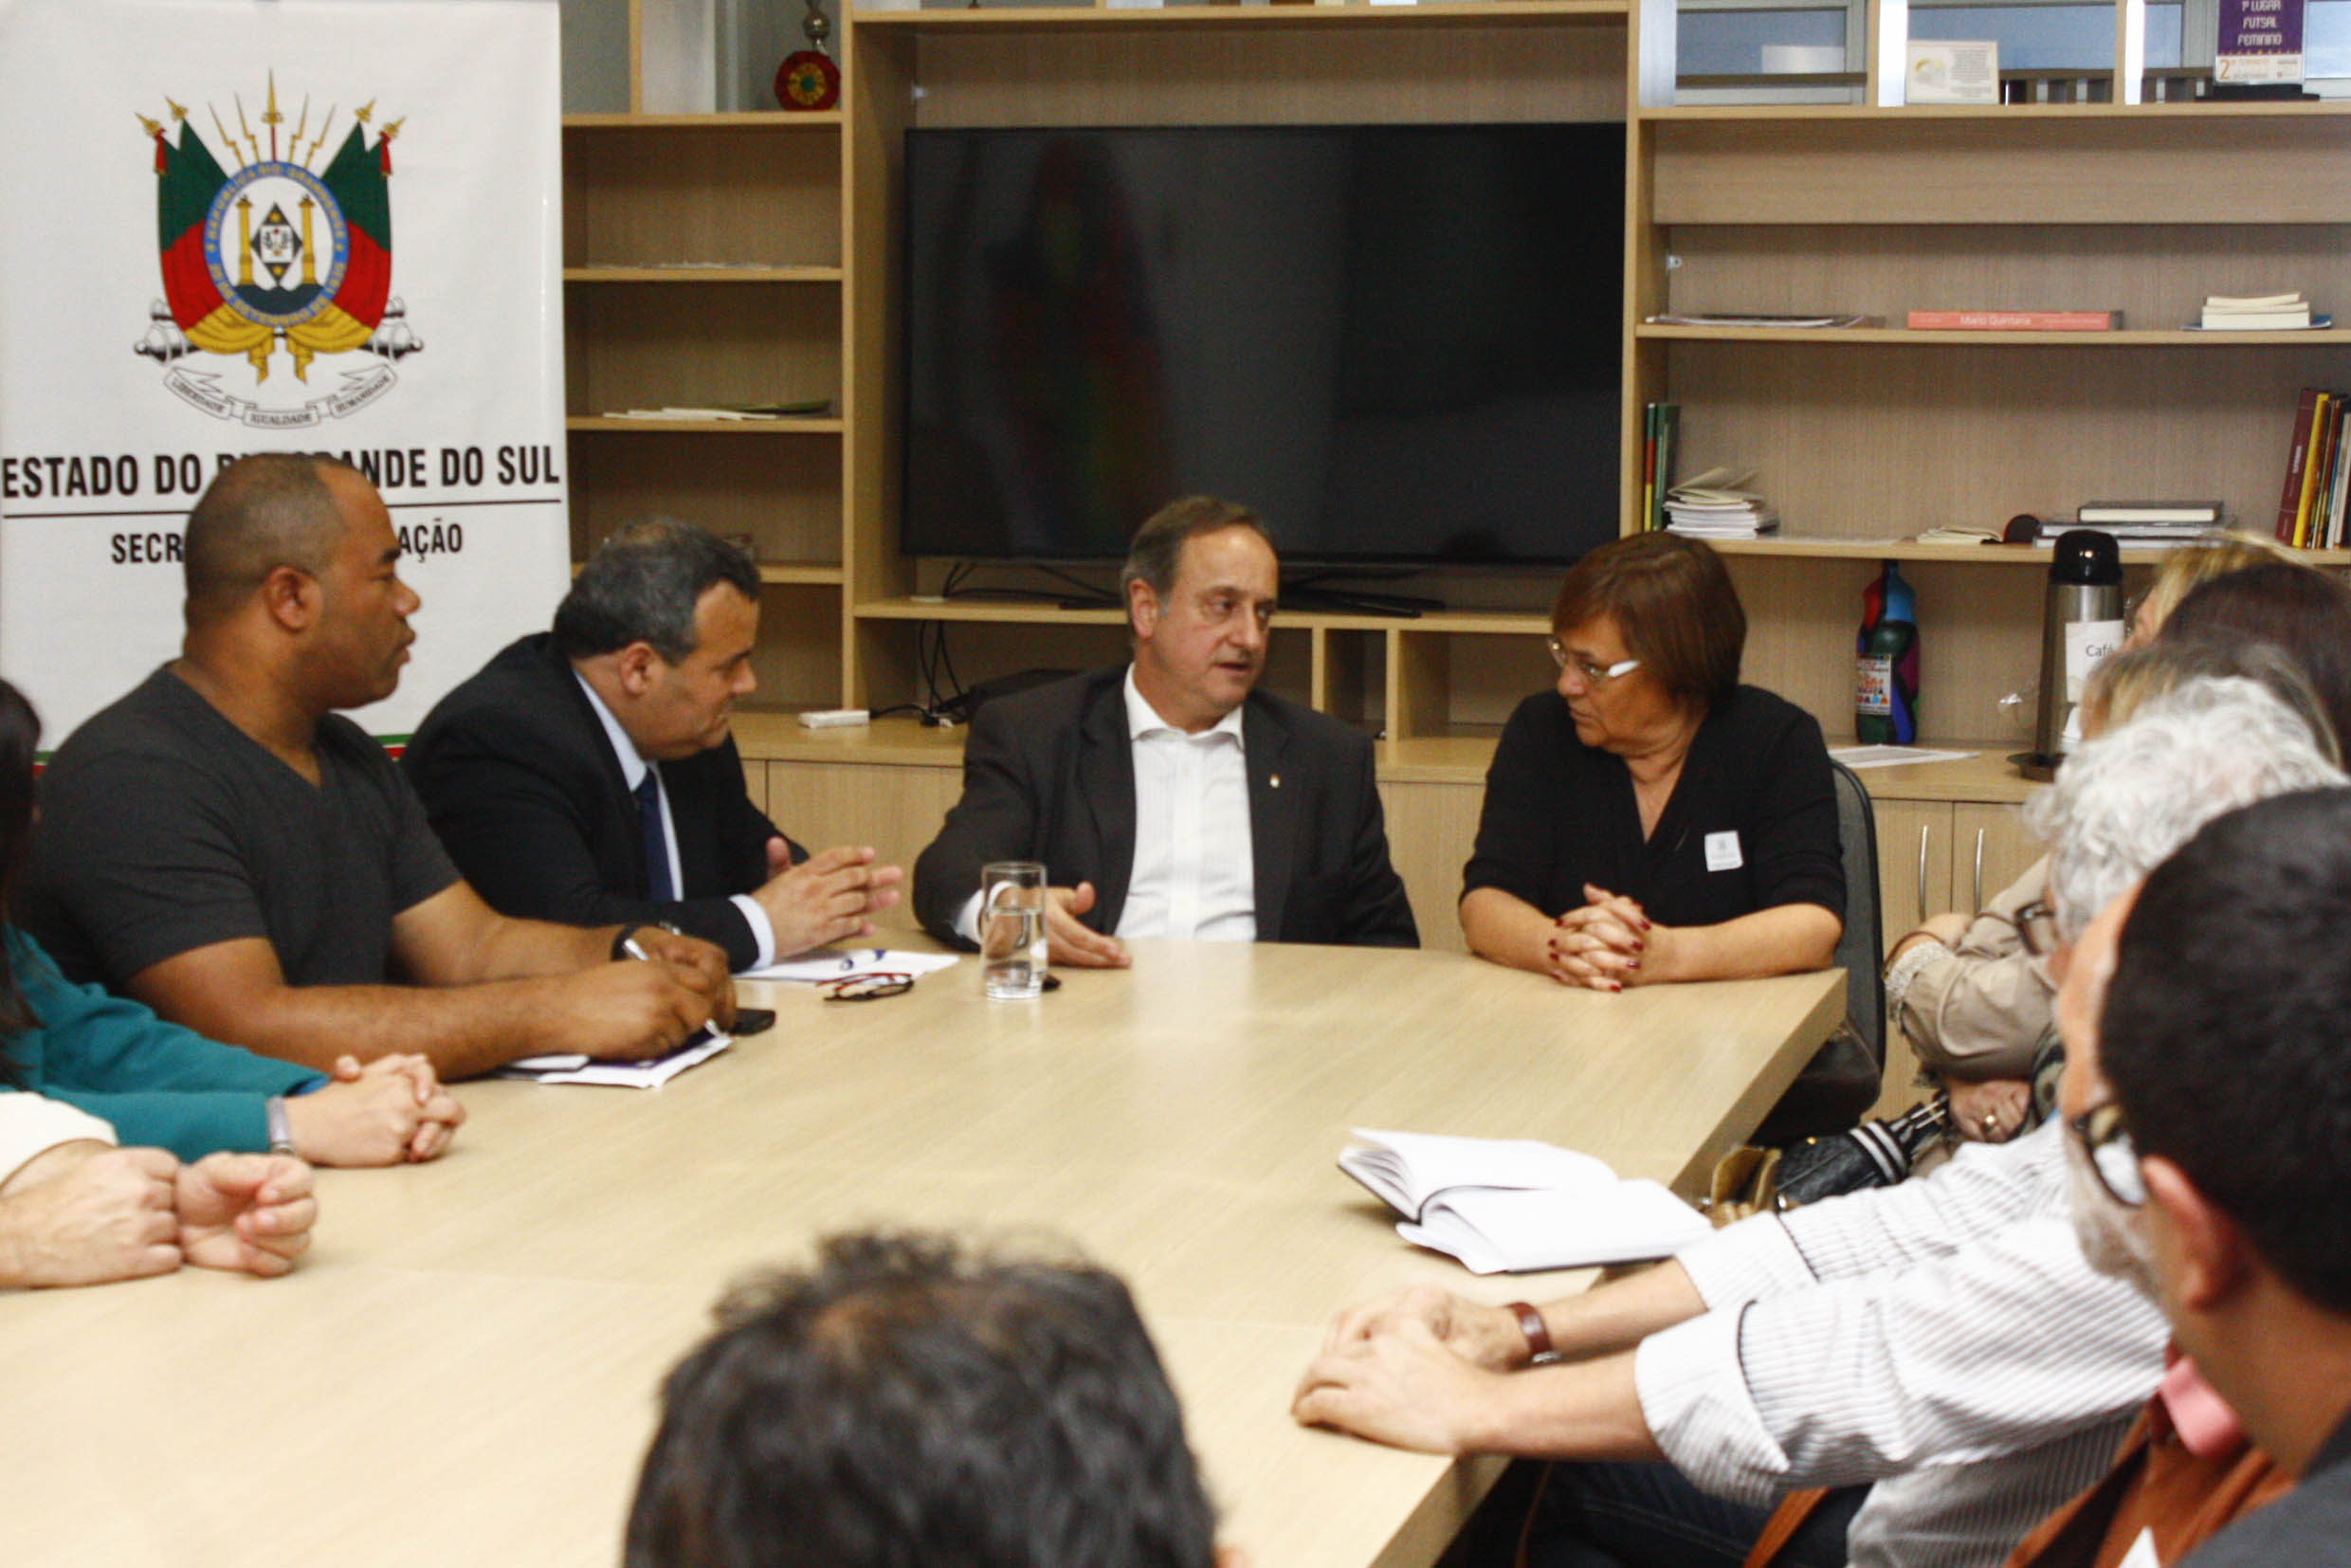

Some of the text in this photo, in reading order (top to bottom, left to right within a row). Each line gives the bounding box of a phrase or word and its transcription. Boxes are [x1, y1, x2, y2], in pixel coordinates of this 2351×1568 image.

[2243, 17, 2277, 29] FUTSAL
[2237, 34, 2283, 46] FEMININO
[249, 413, 313, 426] IGUALDADE
[2, 454, 139, 499] ESTADO
[154, 453, 202, 496] DO
[441, 447, 483, 487] DO
[497, 445, 560, 485] SUL
